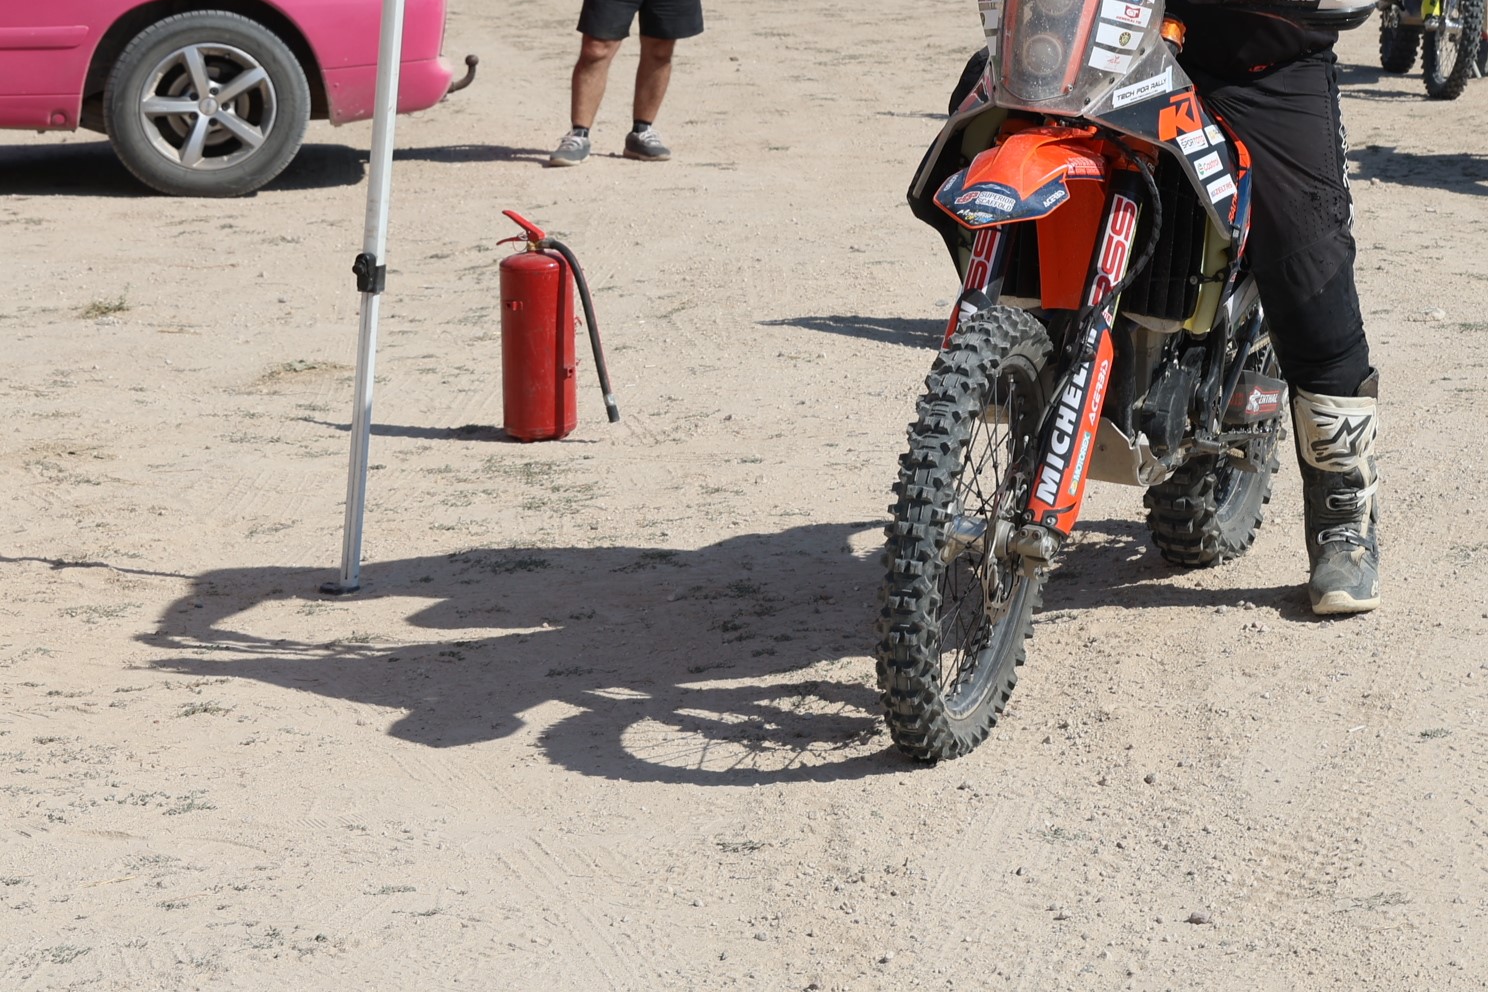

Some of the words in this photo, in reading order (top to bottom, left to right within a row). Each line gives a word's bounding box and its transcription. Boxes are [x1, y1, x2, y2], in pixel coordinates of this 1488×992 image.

[1117, 90, 1135, 102] TECH
[1136, 86, 1150, 95] FOR
[1151, 78, 1167, 91] RALLY
[977, 198, 1012, 211] SCAFFOLD
[981, 192, 1015, 206] SUPERIOR
[1089, 359, 1109, 426] ACERBIS
[1073, 432, 1091, 482] MOTOREX
